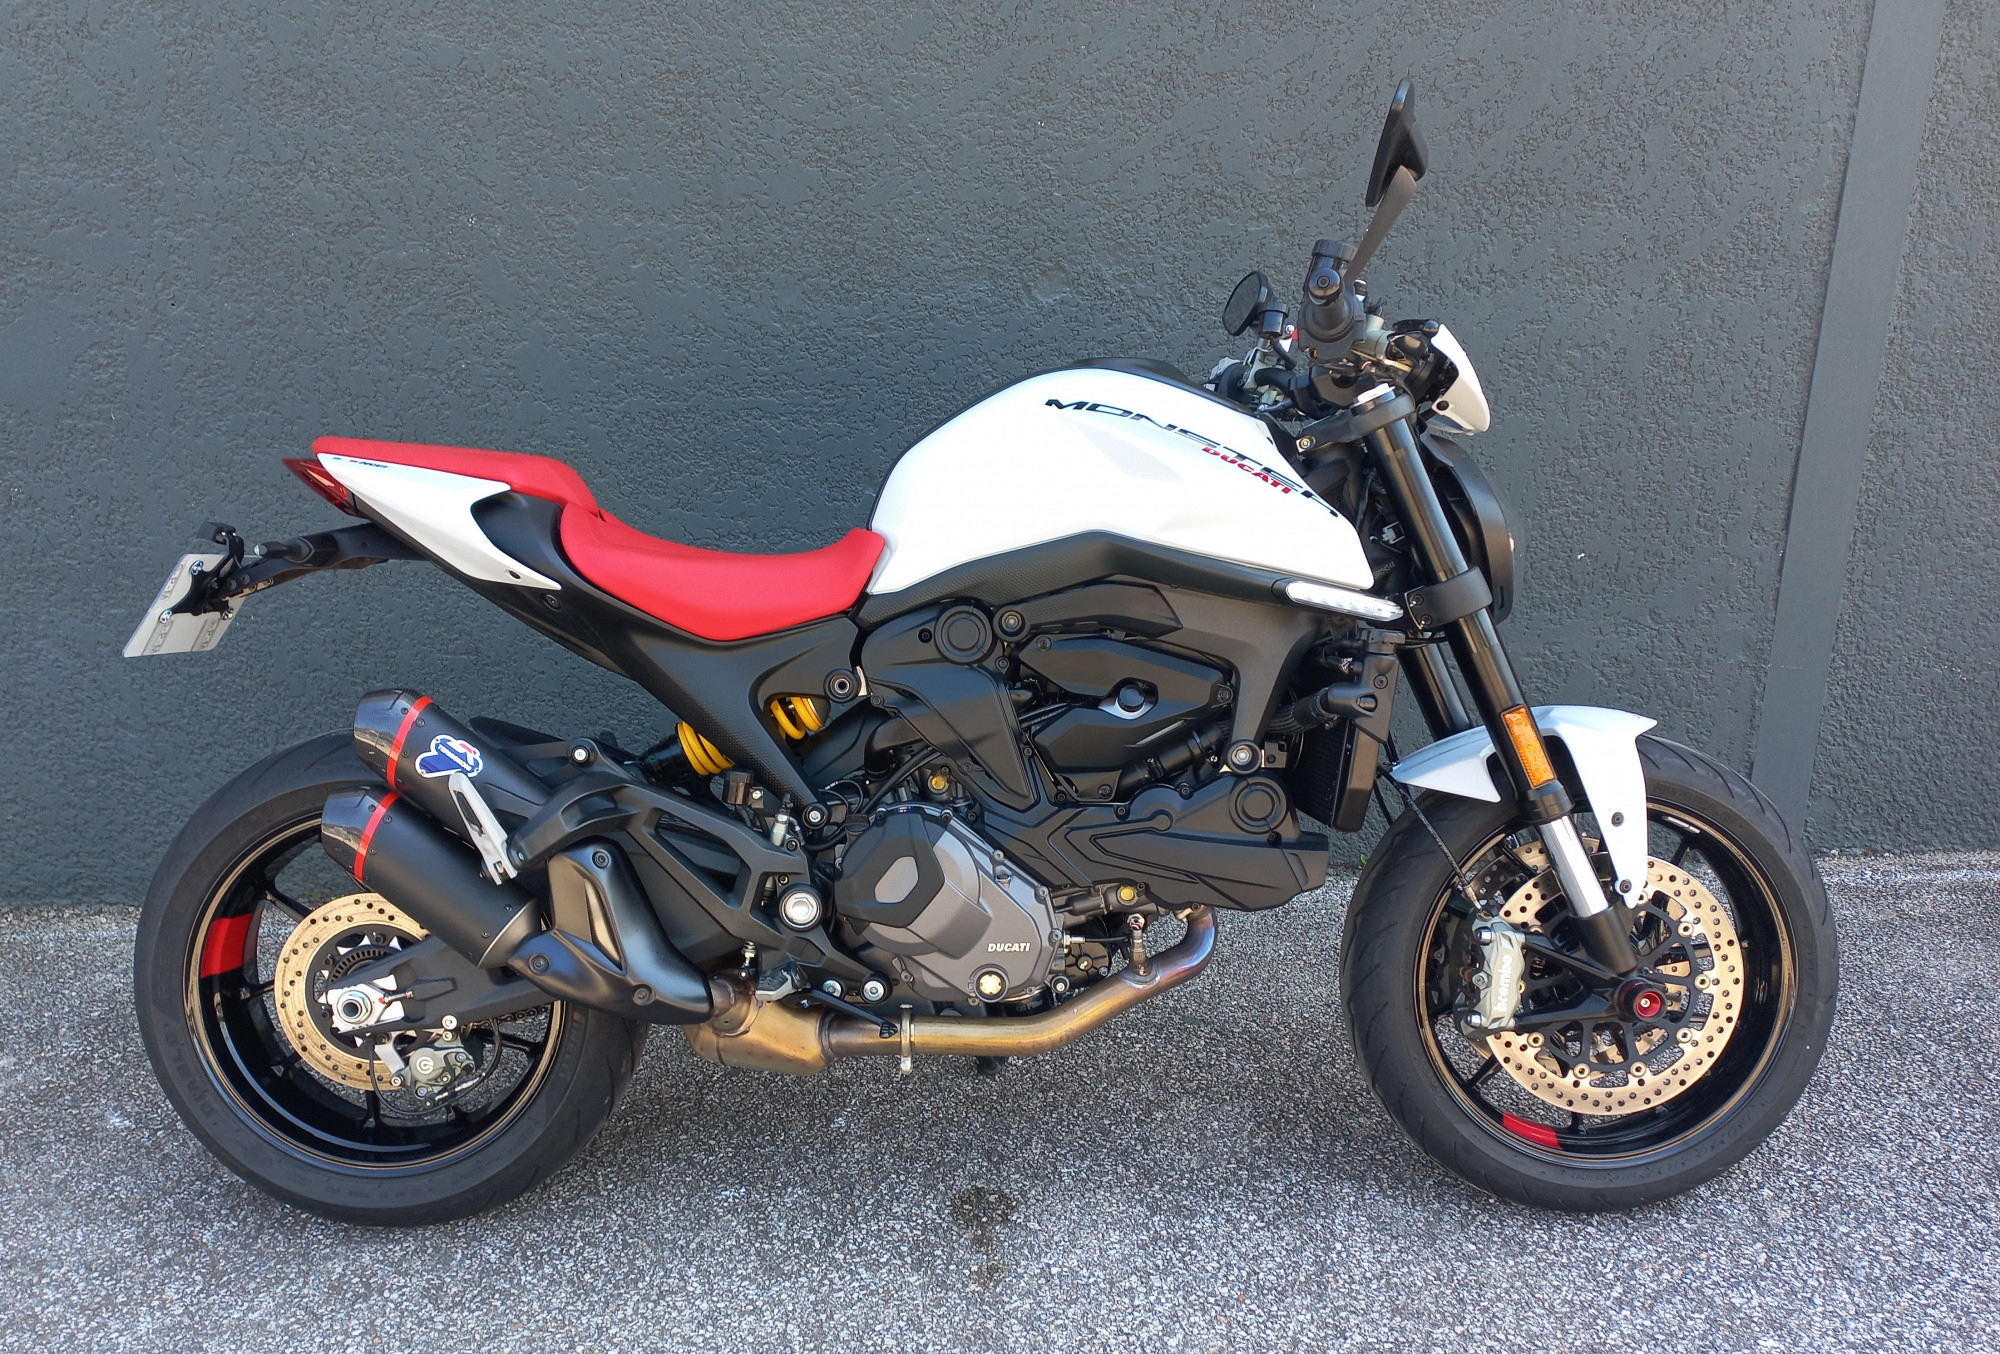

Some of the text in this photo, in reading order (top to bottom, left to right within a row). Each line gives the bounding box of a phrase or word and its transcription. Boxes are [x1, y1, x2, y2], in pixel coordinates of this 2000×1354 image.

[1044, 398, 1338, 517] MONSTER
[1201, 446, 1292, 494] DUCATI
[987, 942, 1031, 952] DUCATI
[1494, 954, 1513, 1013] brembo
